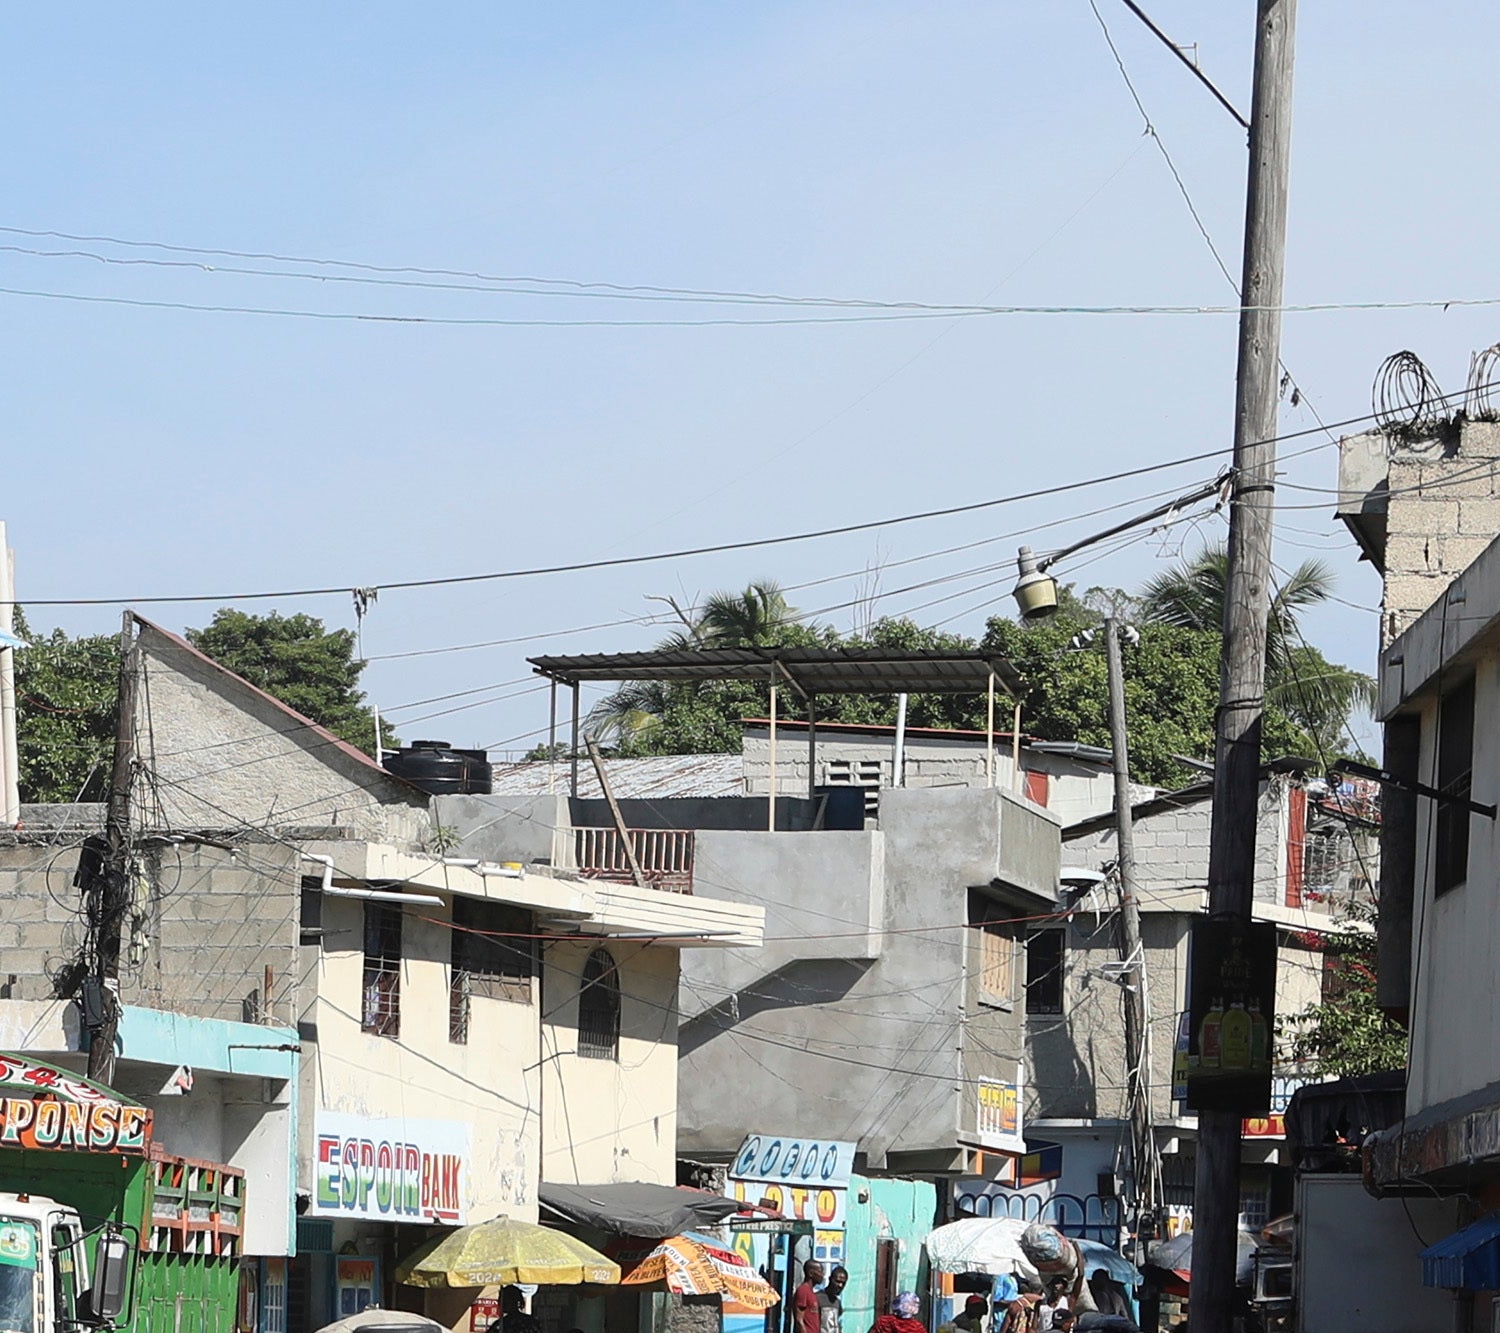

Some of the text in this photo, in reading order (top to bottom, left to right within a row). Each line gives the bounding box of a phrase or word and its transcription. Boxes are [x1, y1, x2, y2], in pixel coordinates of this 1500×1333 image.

[317, 1134, 461, 1216] ESPOIR BANK
[735, 1181, 837, 1222] LOTO
